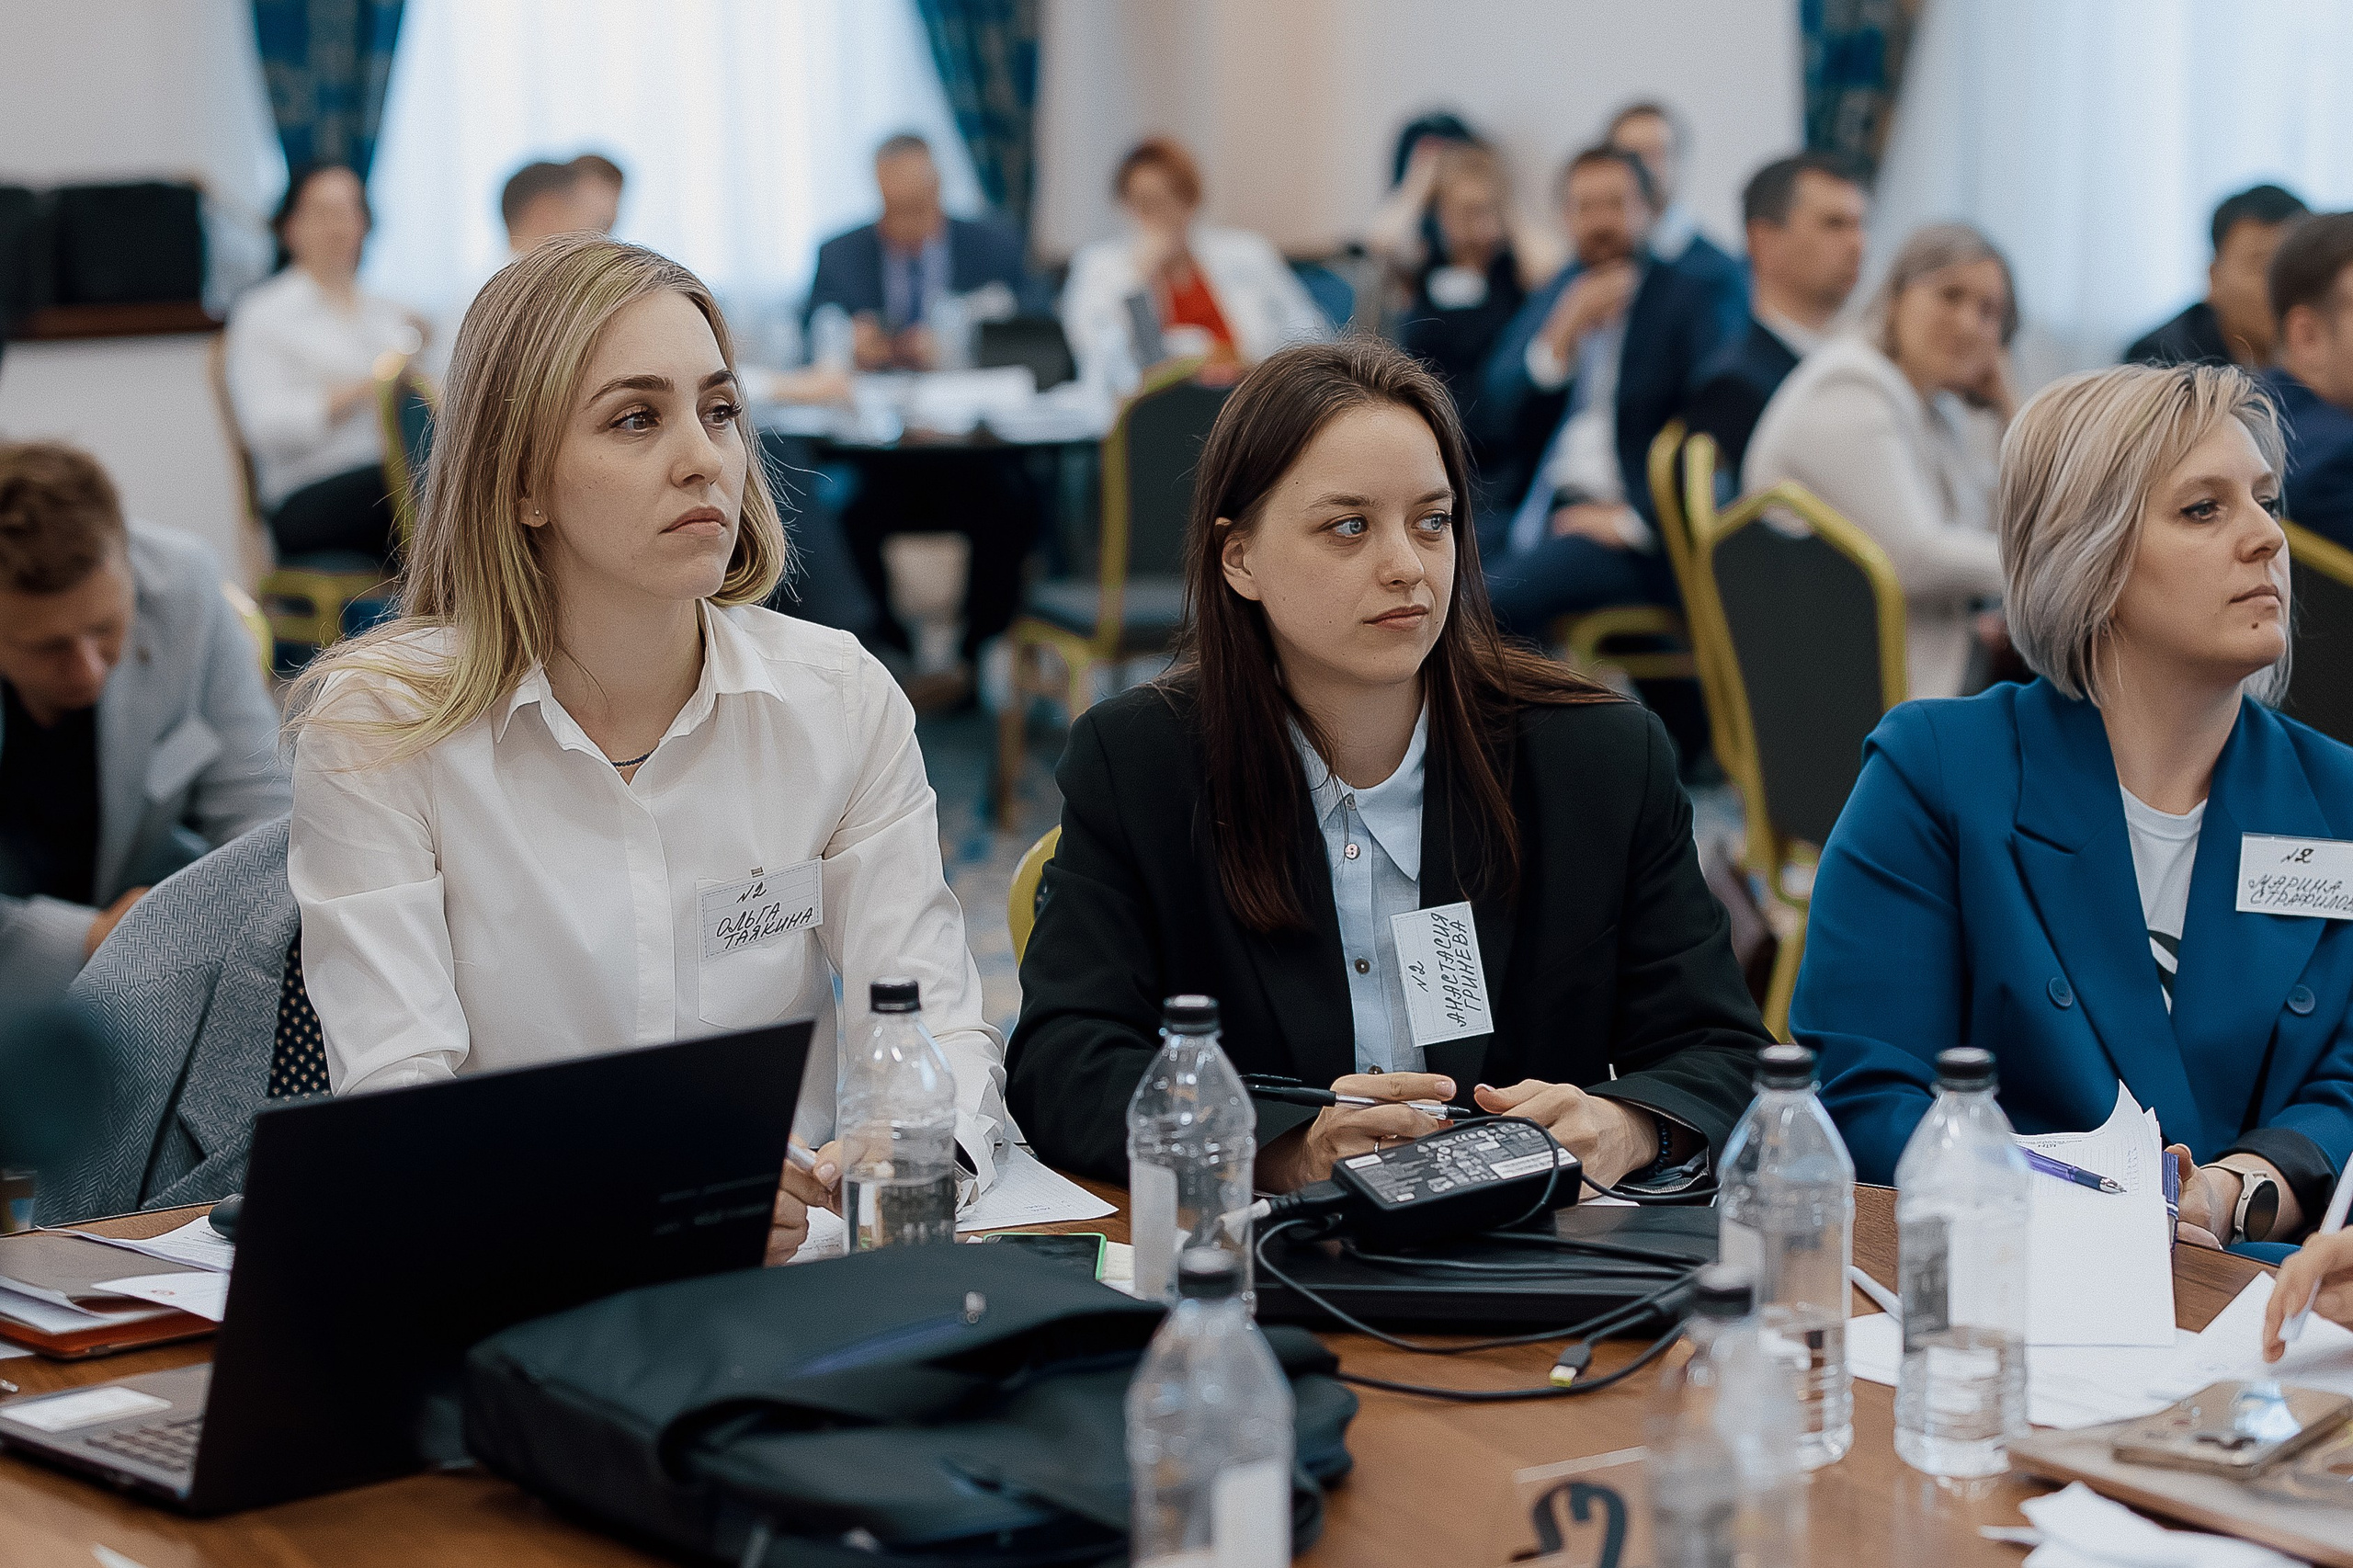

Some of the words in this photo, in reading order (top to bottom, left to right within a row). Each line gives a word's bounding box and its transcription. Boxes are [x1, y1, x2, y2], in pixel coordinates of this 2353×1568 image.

[2248, 874, 2343, 895] МАРИНА
[716, 902, 780, 937] ОЛЬГА
[1430, 912, 1467, 1028] АНАСТАСИЯ
[1449, 920, 1482, 1011] ГРИНЕВА
